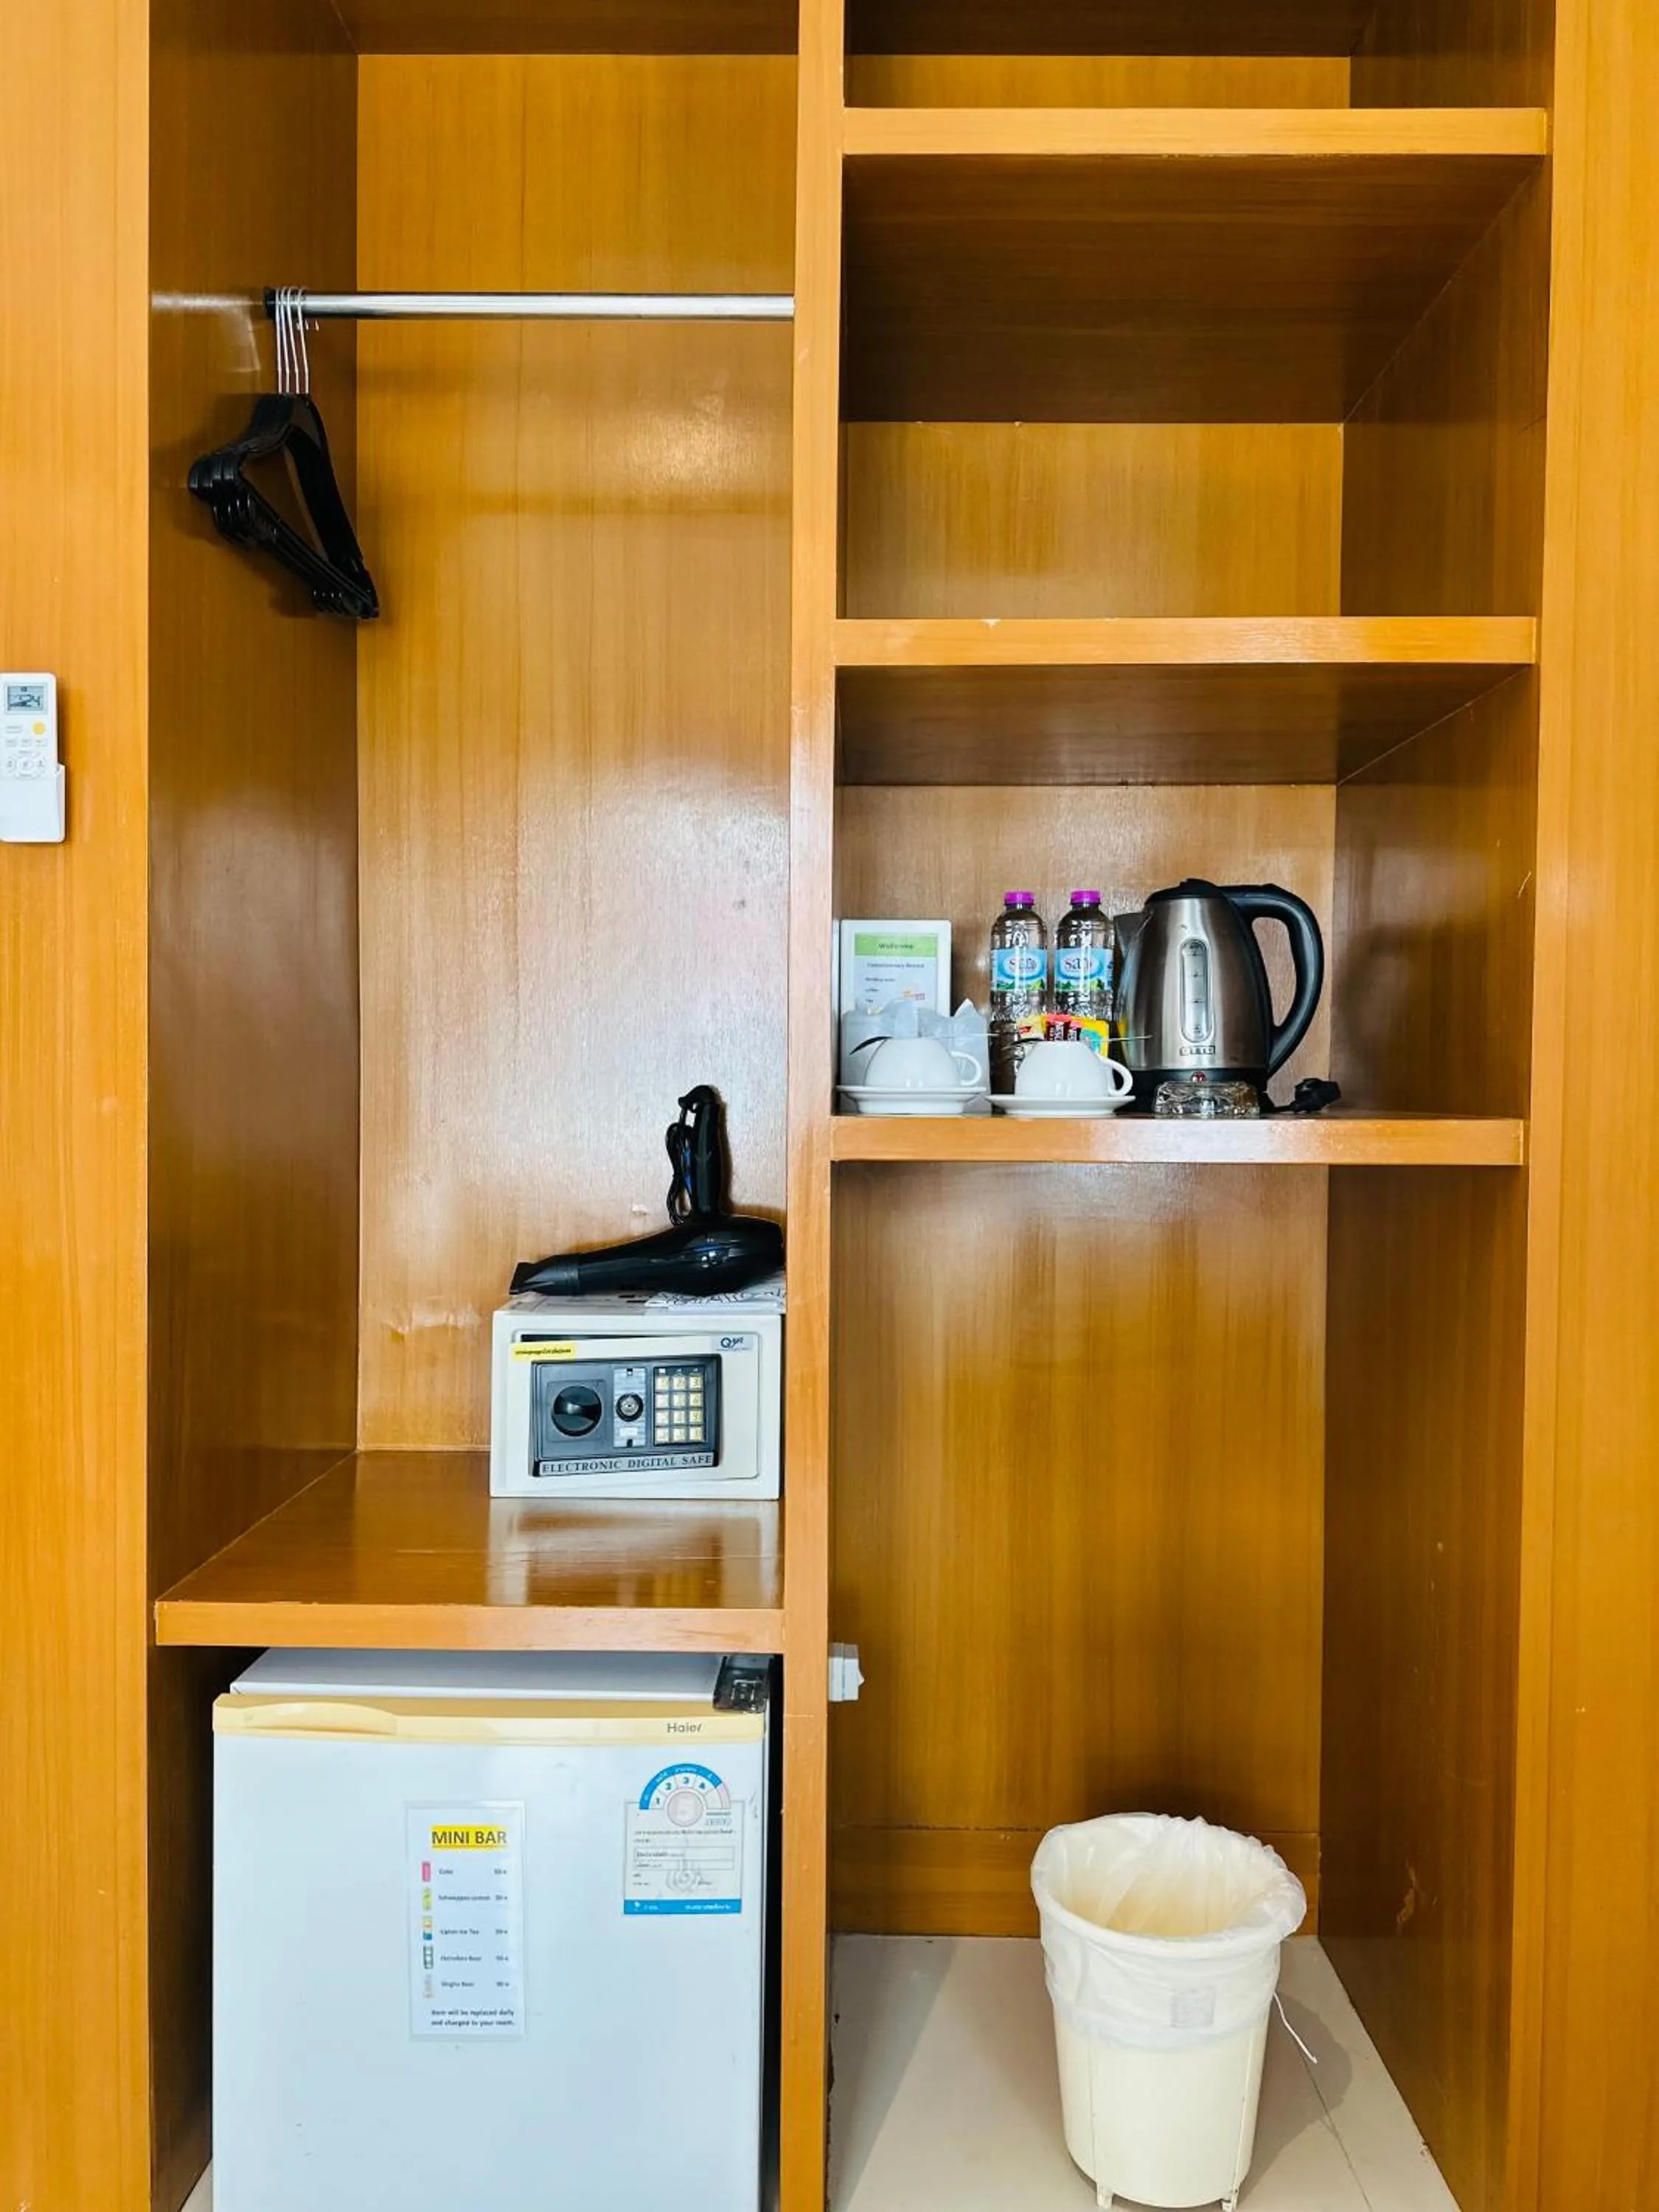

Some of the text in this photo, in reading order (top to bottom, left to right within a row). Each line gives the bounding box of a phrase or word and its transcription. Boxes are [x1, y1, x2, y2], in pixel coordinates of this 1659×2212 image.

[542, 1455, 712, 1473] ELECTRONIC DIGITAL SAFE
[667, 1722, 703, 1733] Haier
[431, 1831, 507, 1844] MINI BAR
[470, 2009, 497, 2017] replaced
[498, 2009, 514, 2017] daily
[445, 2020, 470, 2028] charged
